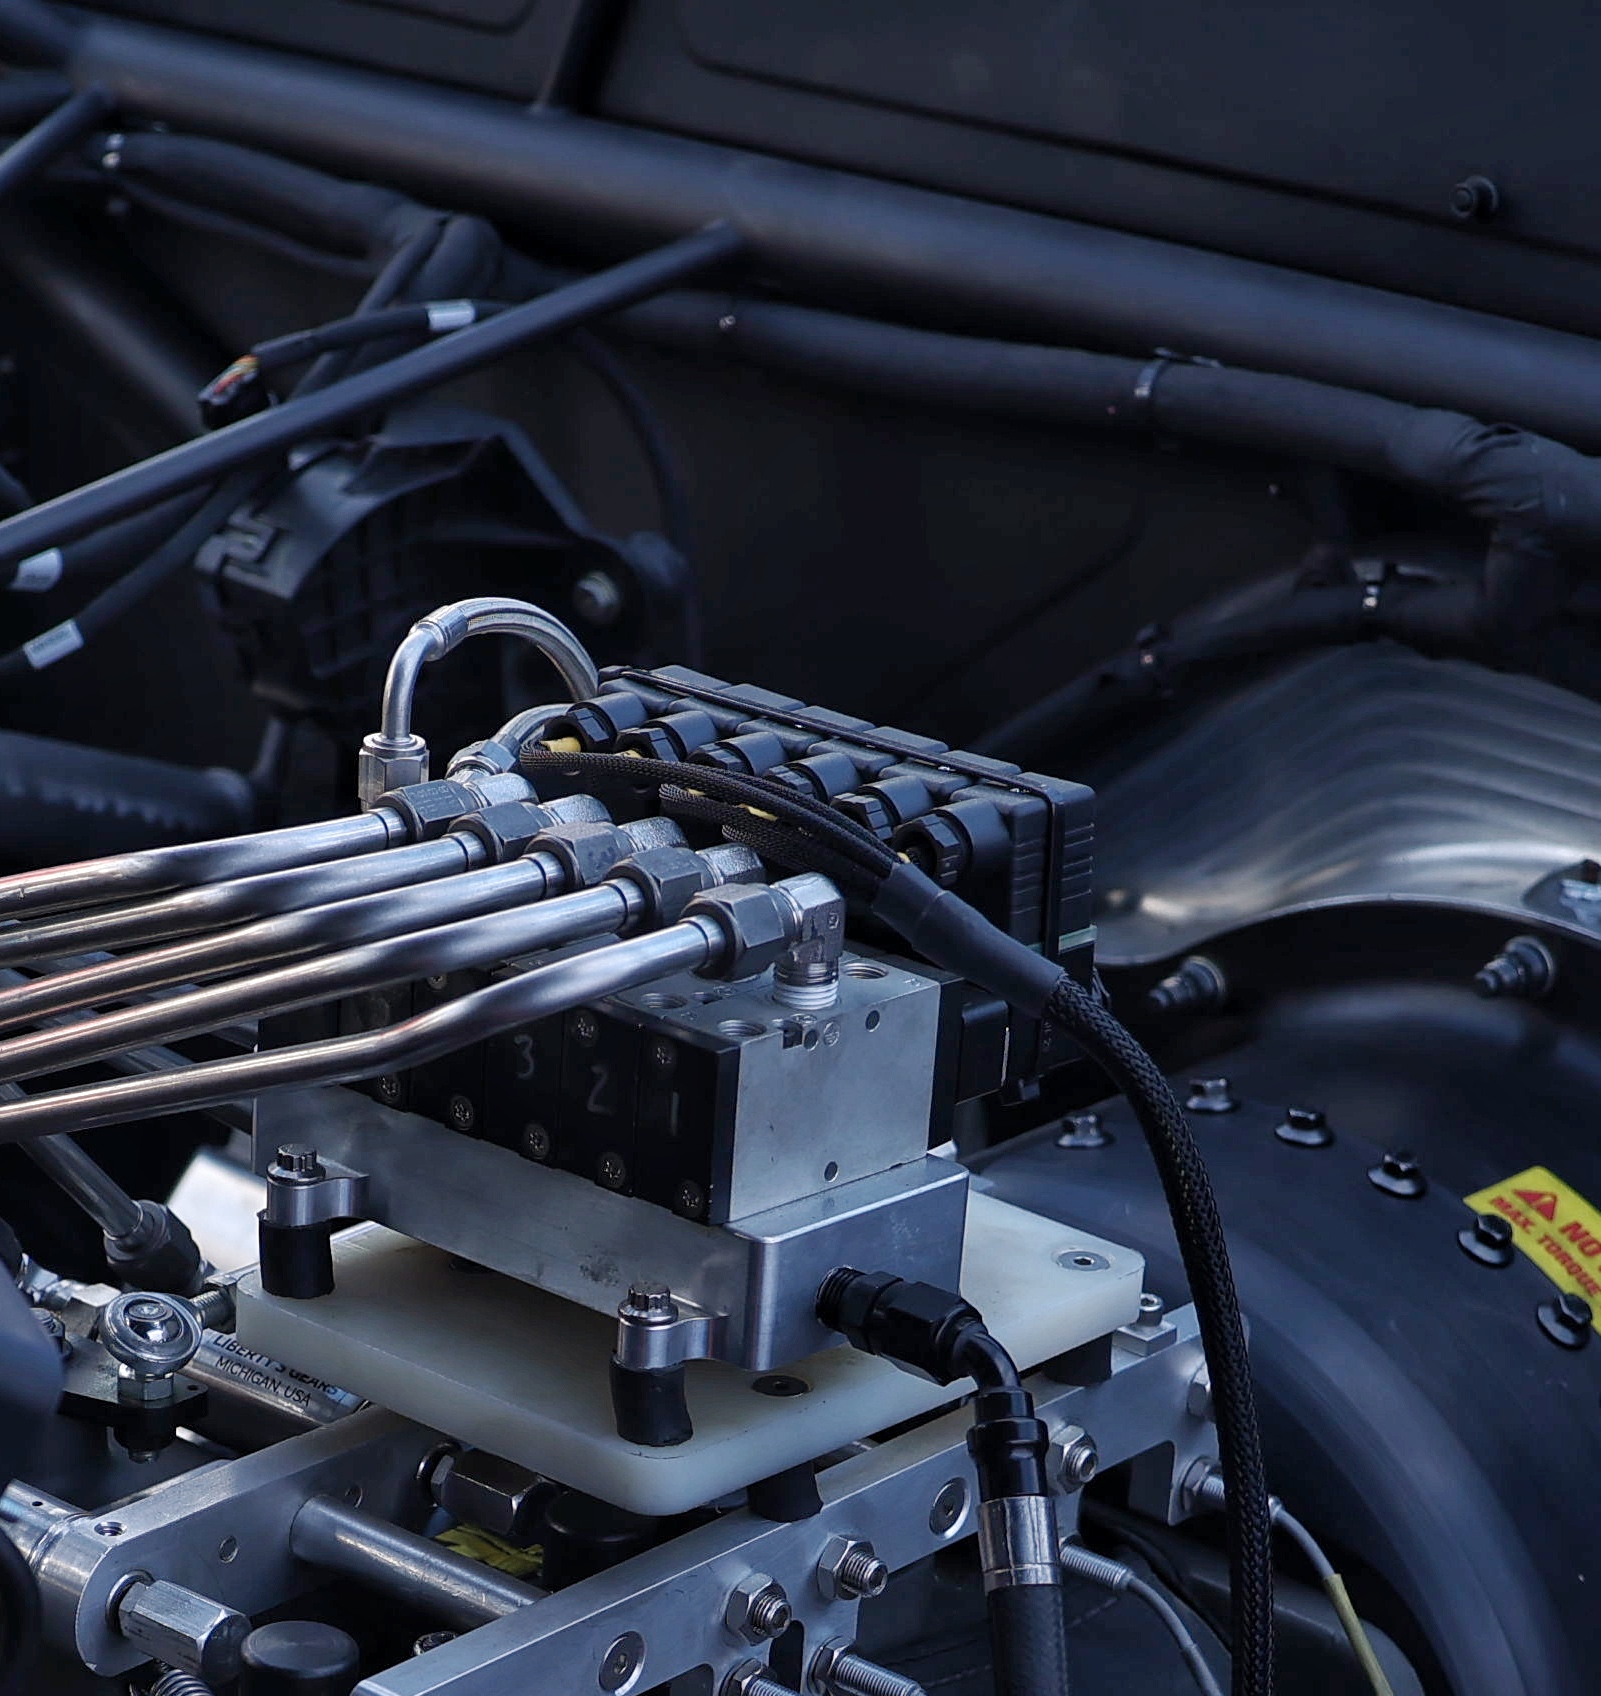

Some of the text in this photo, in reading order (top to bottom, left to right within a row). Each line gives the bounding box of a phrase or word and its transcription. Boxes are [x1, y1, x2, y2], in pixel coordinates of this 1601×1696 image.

[512, 1034, 536, 1080] 3
[586, 1063, 617, 1118] 2
[282, 1384, 312, 1407] USA
